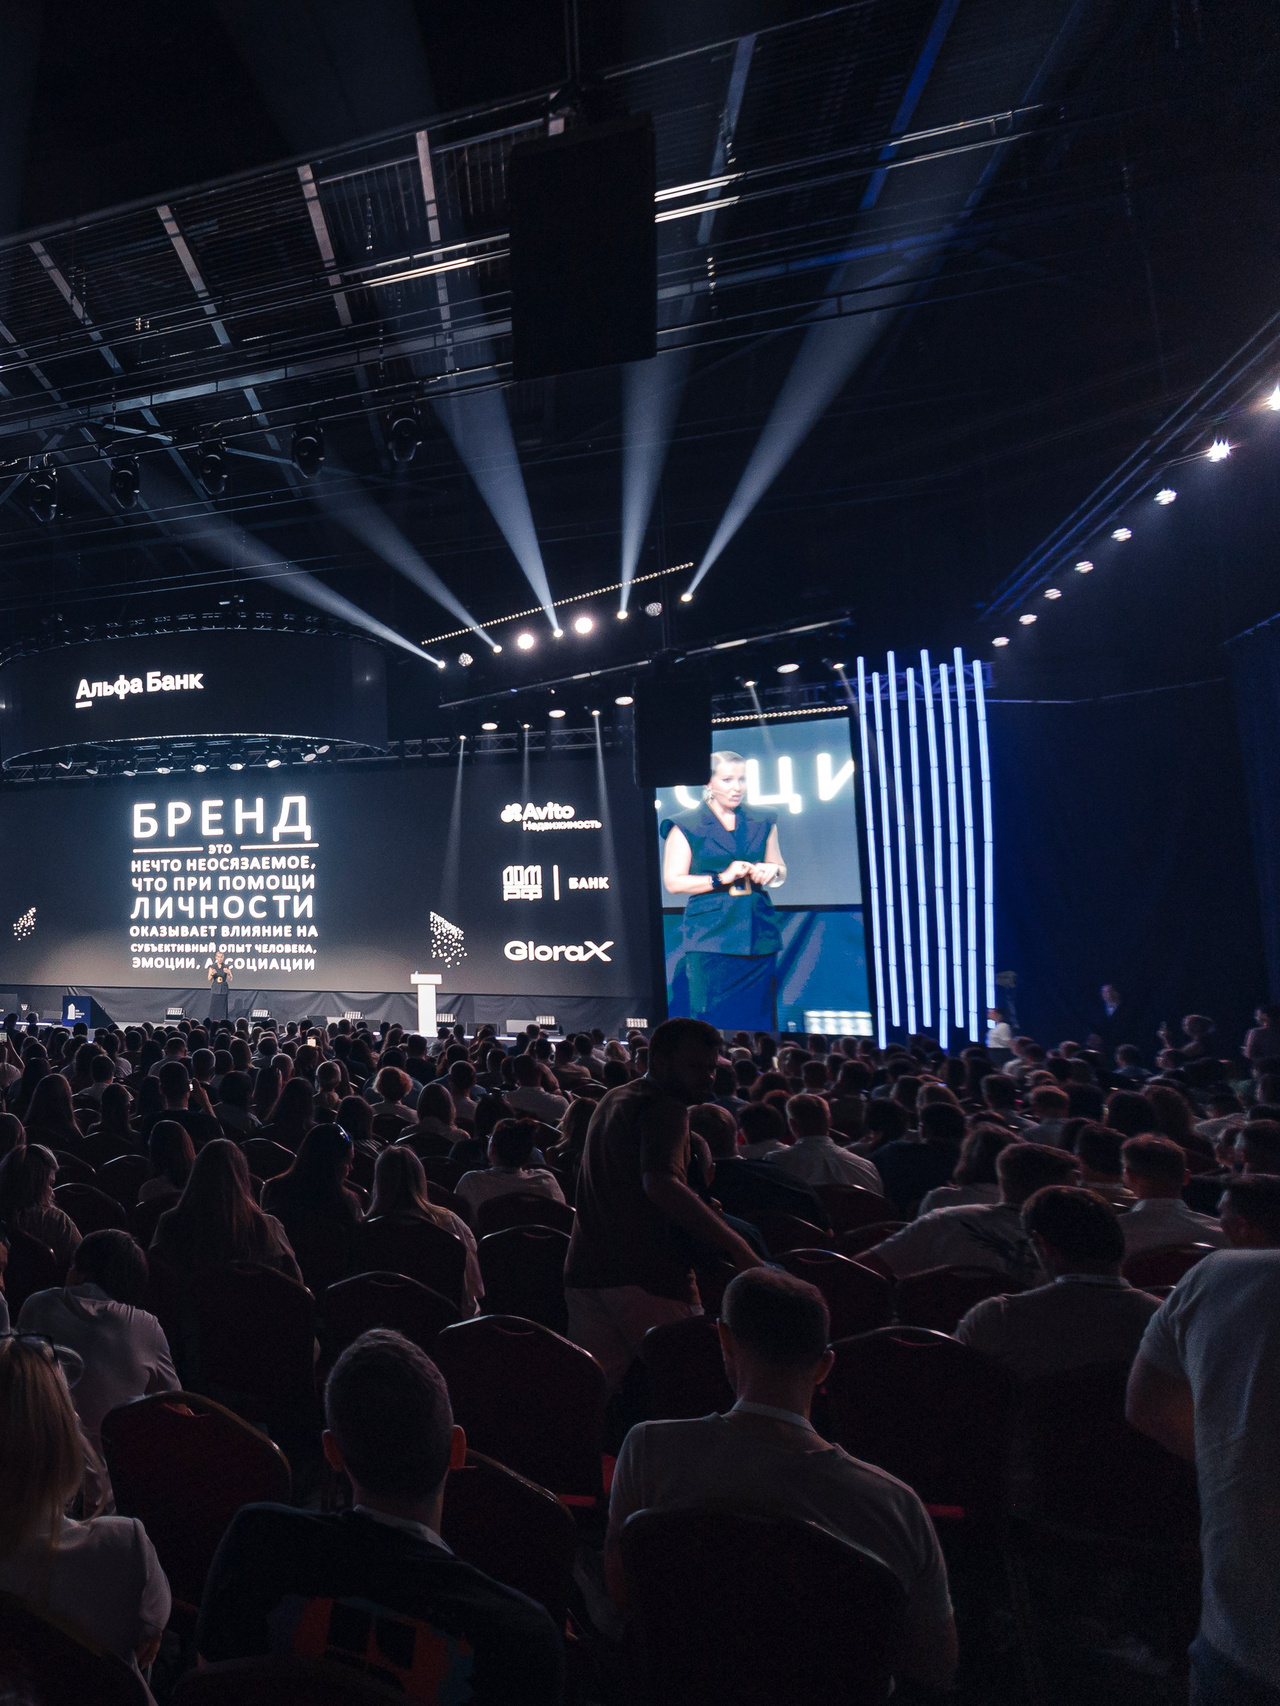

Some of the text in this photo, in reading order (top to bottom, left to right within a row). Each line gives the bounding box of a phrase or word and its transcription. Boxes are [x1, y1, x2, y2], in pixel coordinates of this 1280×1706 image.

[76, 671, 204, 700] Альфа Банк
[133, 796, 311, 842] БРЕНД
[522, 802, 575, 820] Avito
[523, 820, 602, 831] Недвижимость
[208, 844, 233, 855] ЭТО
[131, 856, 316, 873] НЕЧТО НЕОСЯЗАЕМОЕ,
[131, 874, 315, 892] ЧТО ПРИ ПОМОЩИ
[568, 877, 609, 889] БАНК
[130, 895, 313, 919] ЛИЧНОСТИ
[129, 925, 319, 938] ОКАЗЫВАЕТ ВЛИЯНИЕ НА
[130, 942, 317, 954] СУБЪЕКТИВНЫЙ ОПЫТ ЧЕЛОВЕКА,
[504, 940, 614, 962] GloraX
[132, 957, 315, 972] ЭМОЦИИ, АСОЦИАЦИИ
